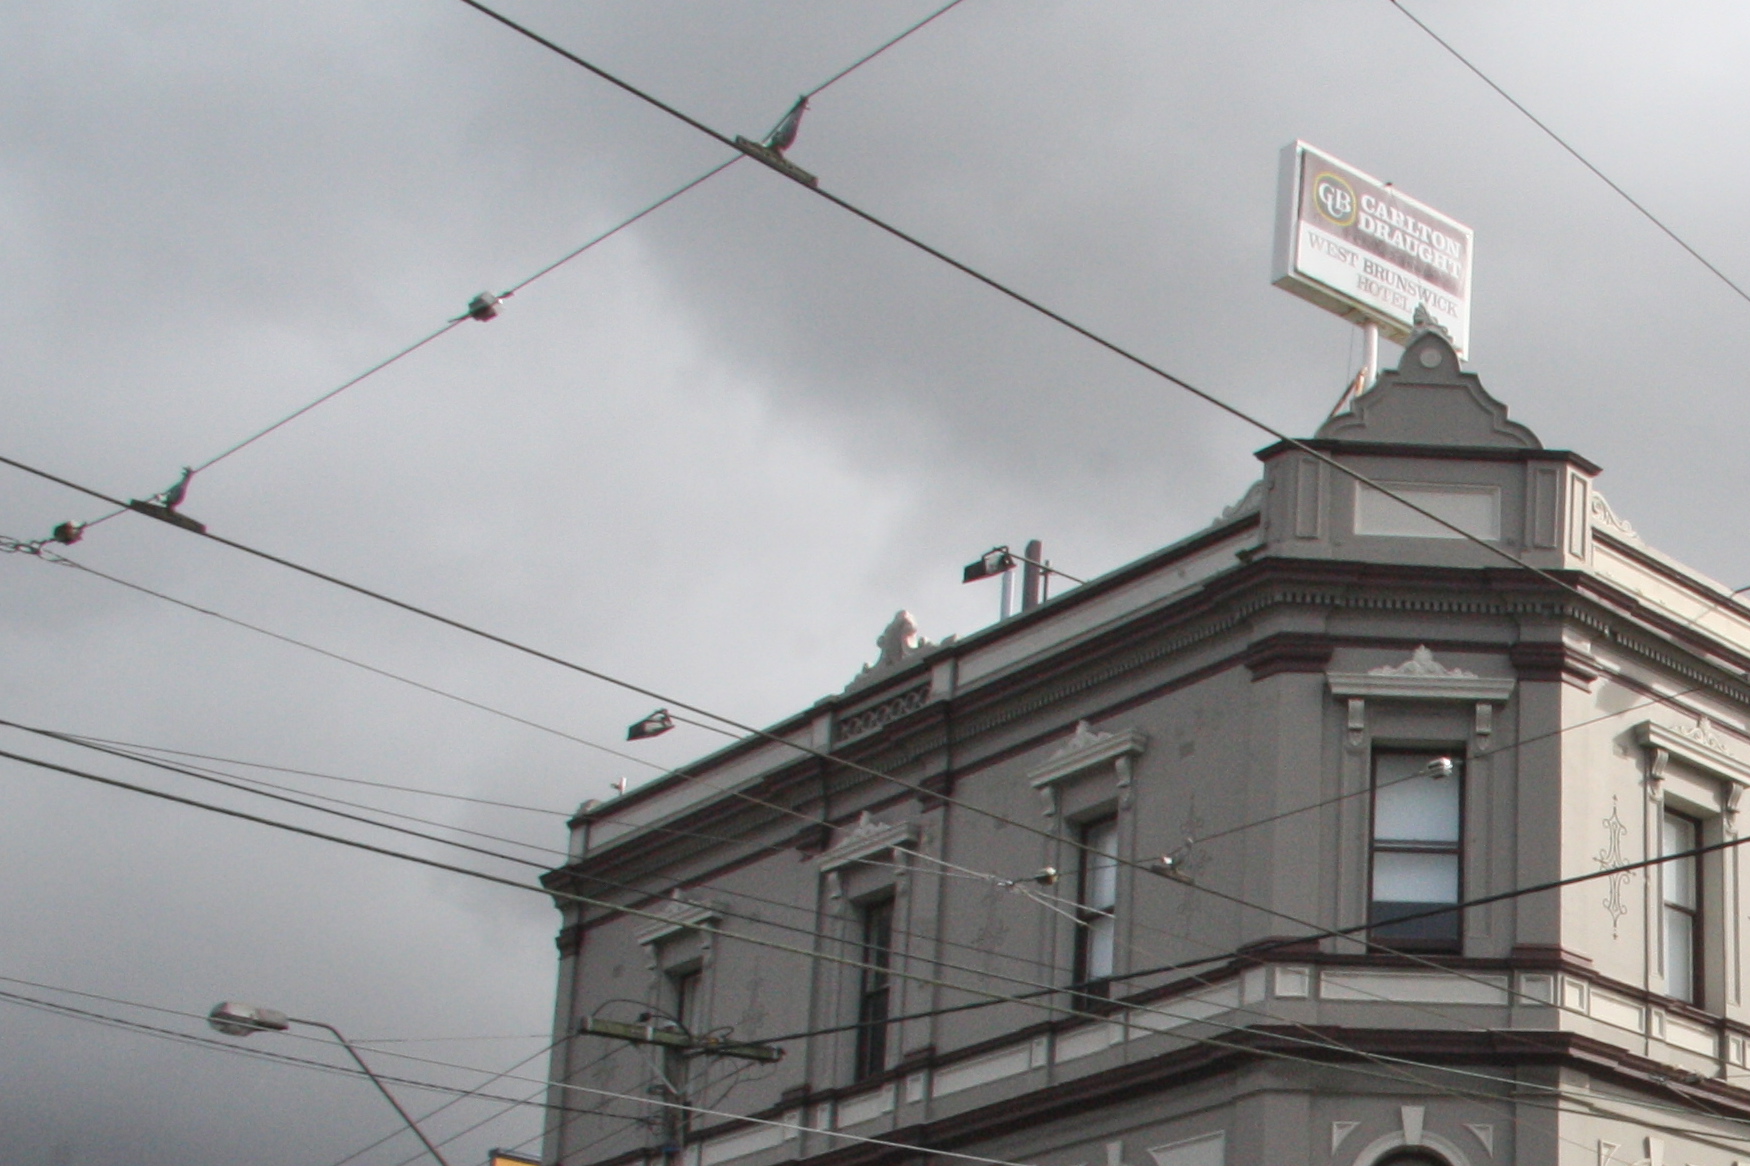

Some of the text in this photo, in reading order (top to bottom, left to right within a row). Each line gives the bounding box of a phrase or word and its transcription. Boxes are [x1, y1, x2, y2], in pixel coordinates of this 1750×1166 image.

[1358, 214, 1461, 279] DRAUGHT
[1361, 194, 1461, 258] CARLTON
[1308, 231, 1458, 318] WEST BRUNSWICK
[1357, 274, 1412, 313] HOTEL
